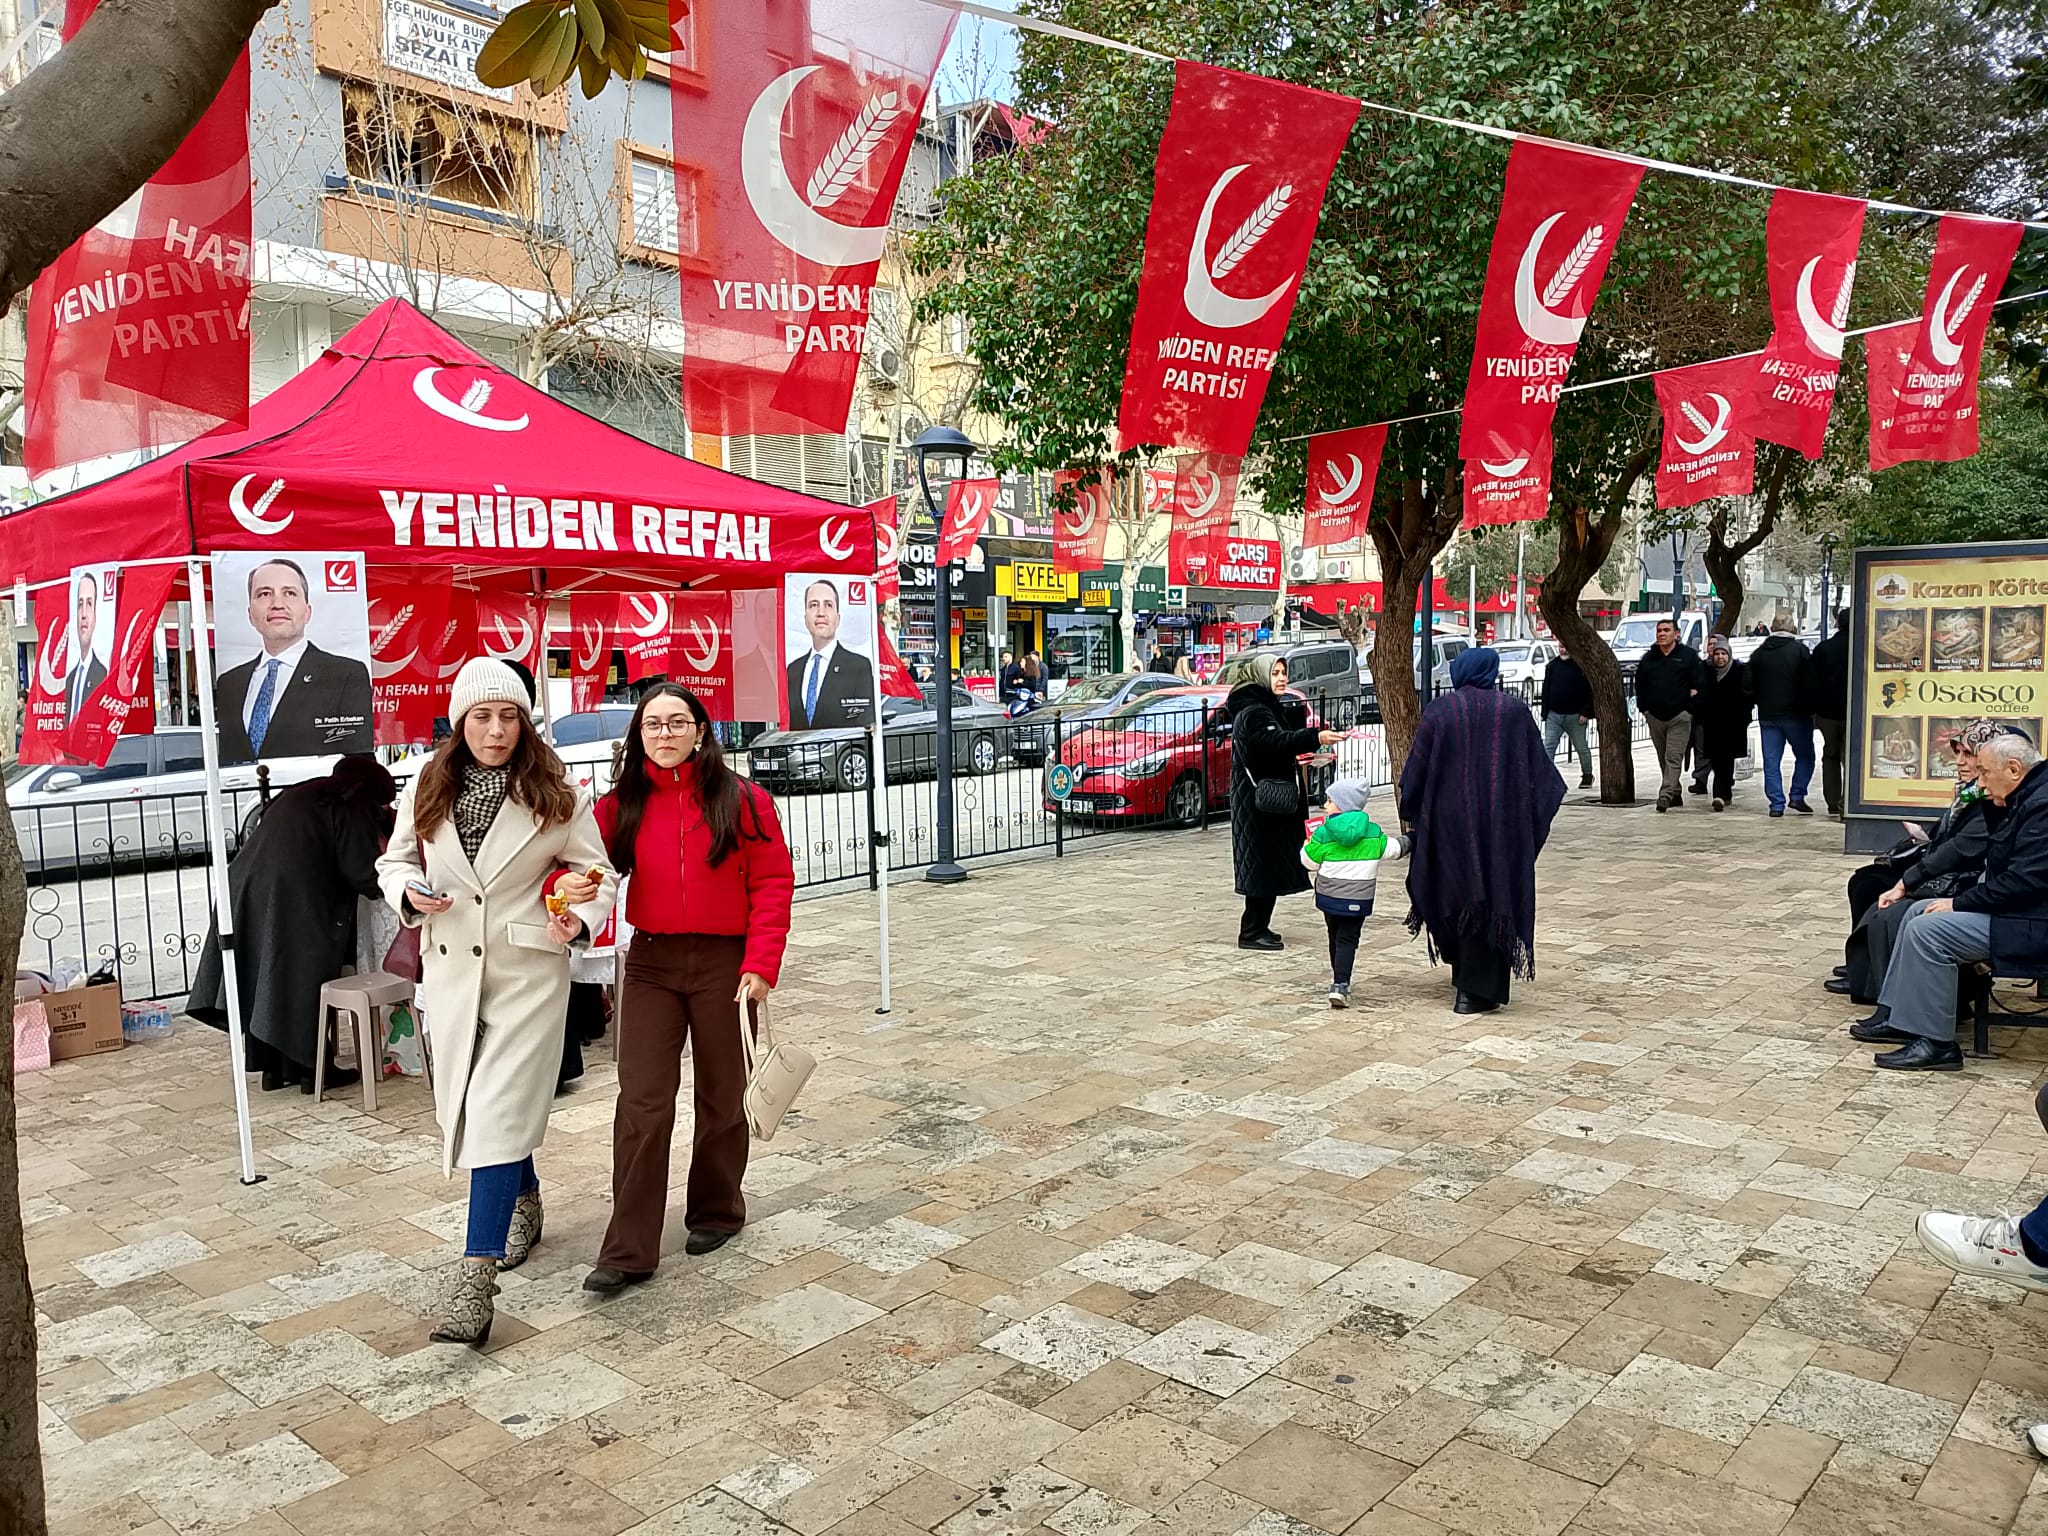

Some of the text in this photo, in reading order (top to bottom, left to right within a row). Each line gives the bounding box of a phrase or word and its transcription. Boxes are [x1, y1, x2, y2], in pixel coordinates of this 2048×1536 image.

[713, 277, 861, 312] YENİDEN
[1486, 354, 1574, 378] YENİDEN
[1162, 367, 1248, 400] PARTİSİ
[378, 483, 772, 562] YENİDEN REFAH
[1227, 541, 1268, 565] ÇARŞI
[1017, 565, 1065, 588] EYFEL
[1090, 580, 1119, 591] DAVID
[1219, 564, 1276, 584] MARKET
[1083, 591, 1105, 601] EYFEL
[1912, 581, 1983, 599] Kazan
[385, 683, 429, 697] REFAH
[1918, 679, 2035, 705] Osasco
[1985, 702, 2030, 714] coffee
